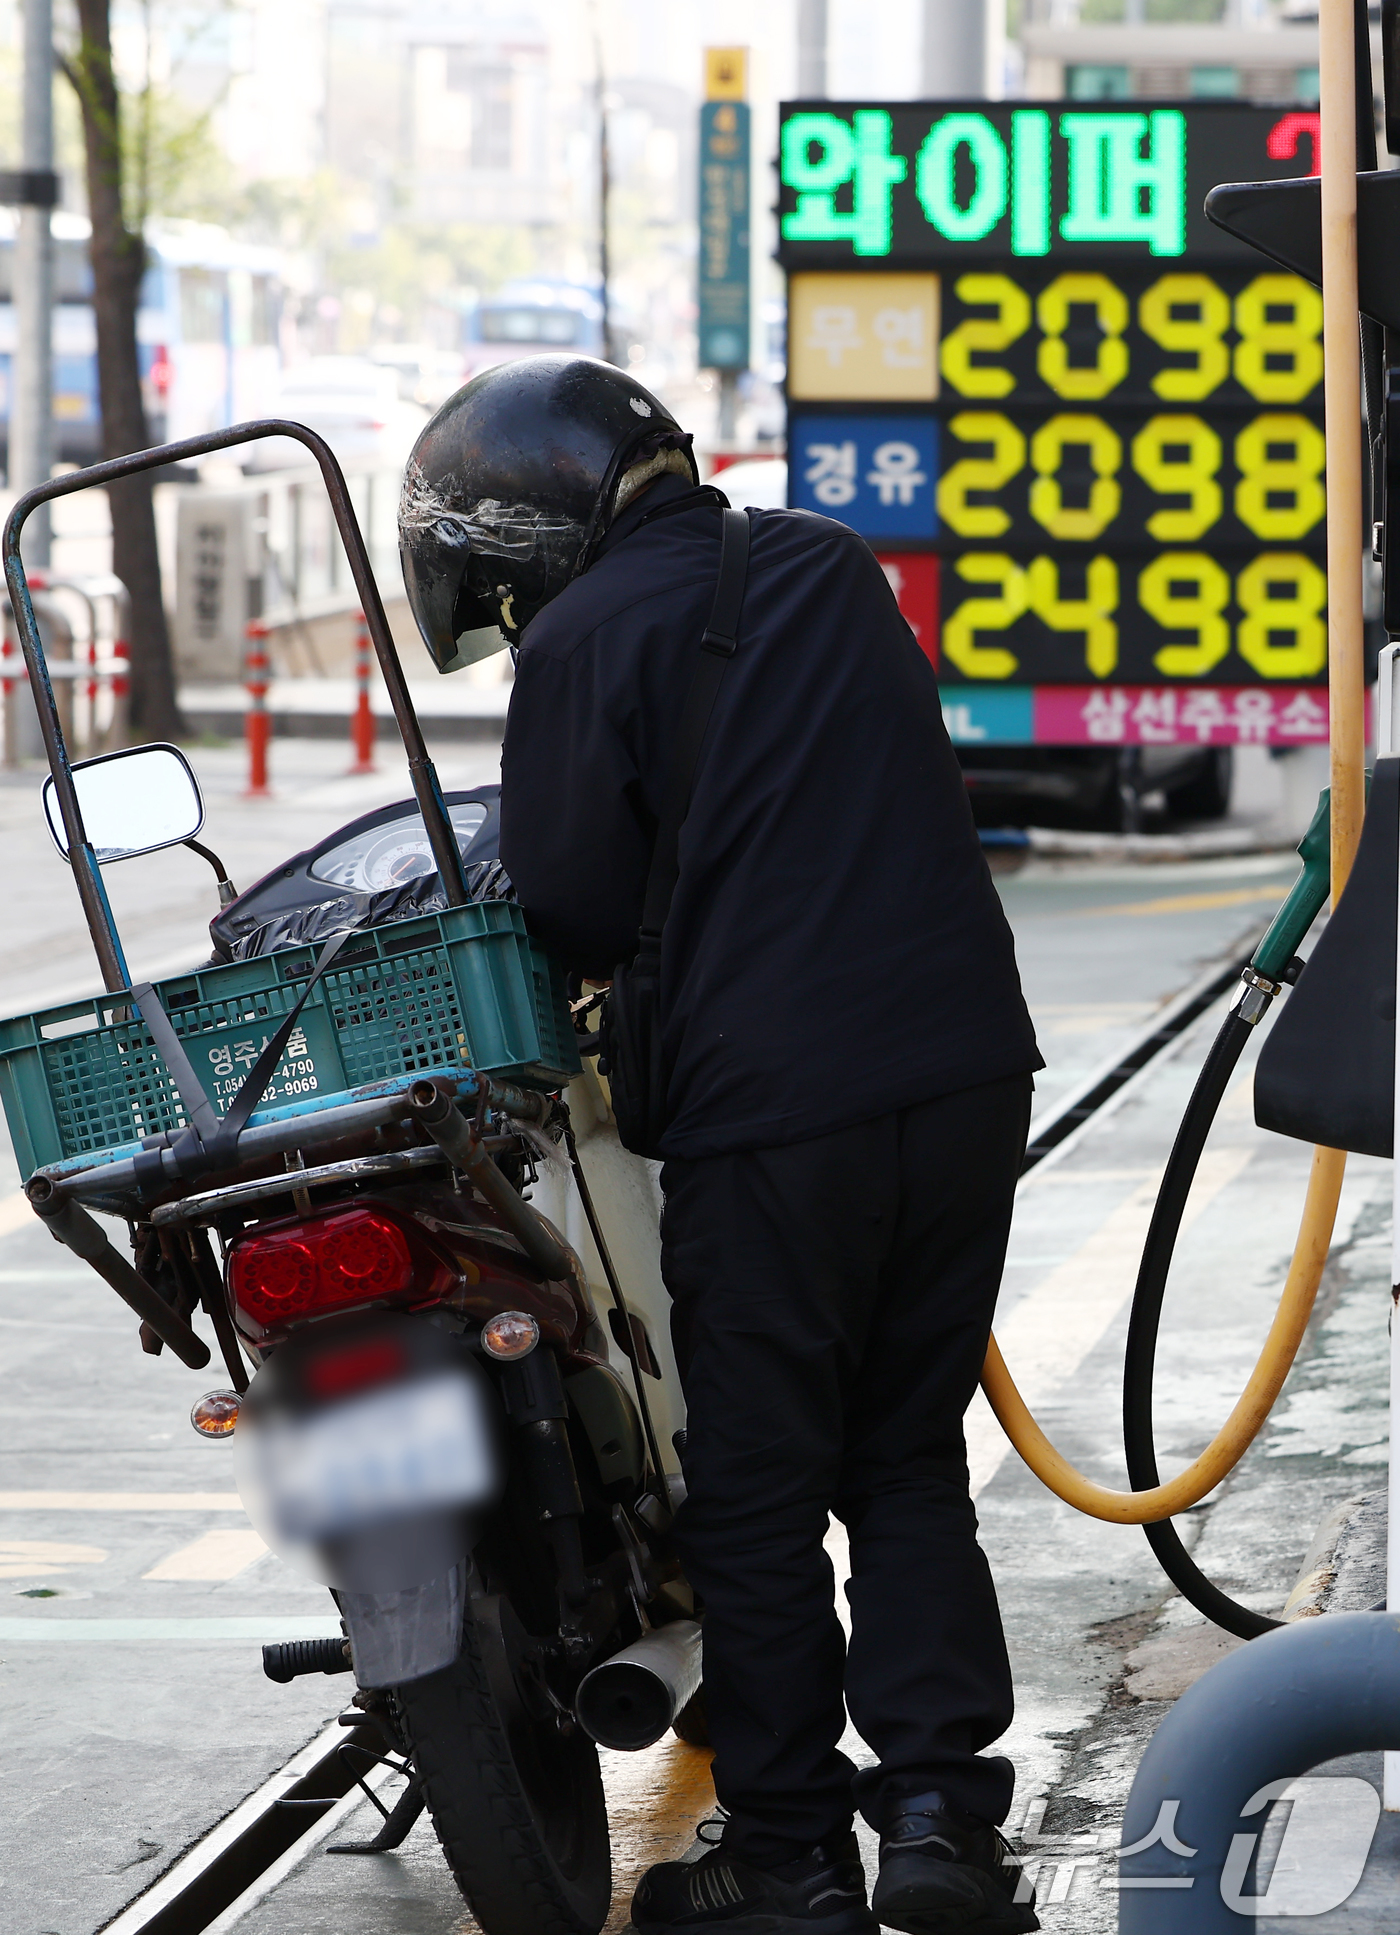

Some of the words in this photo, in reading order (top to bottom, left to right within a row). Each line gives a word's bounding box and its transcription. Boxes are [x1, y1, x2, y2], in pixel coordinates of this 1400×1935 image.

[781, 110, 1186, 256] 와이퍼
[806, 306, 924, 369] 무연
[940, 272, 1325, 401] 2098
[804, 440, 926, 507] 경유
[935, 411, 1326, 540] 2098
[942, 552, 1327, 678] 2498
[1081, 691, 1329, 742] 삼선주유소
